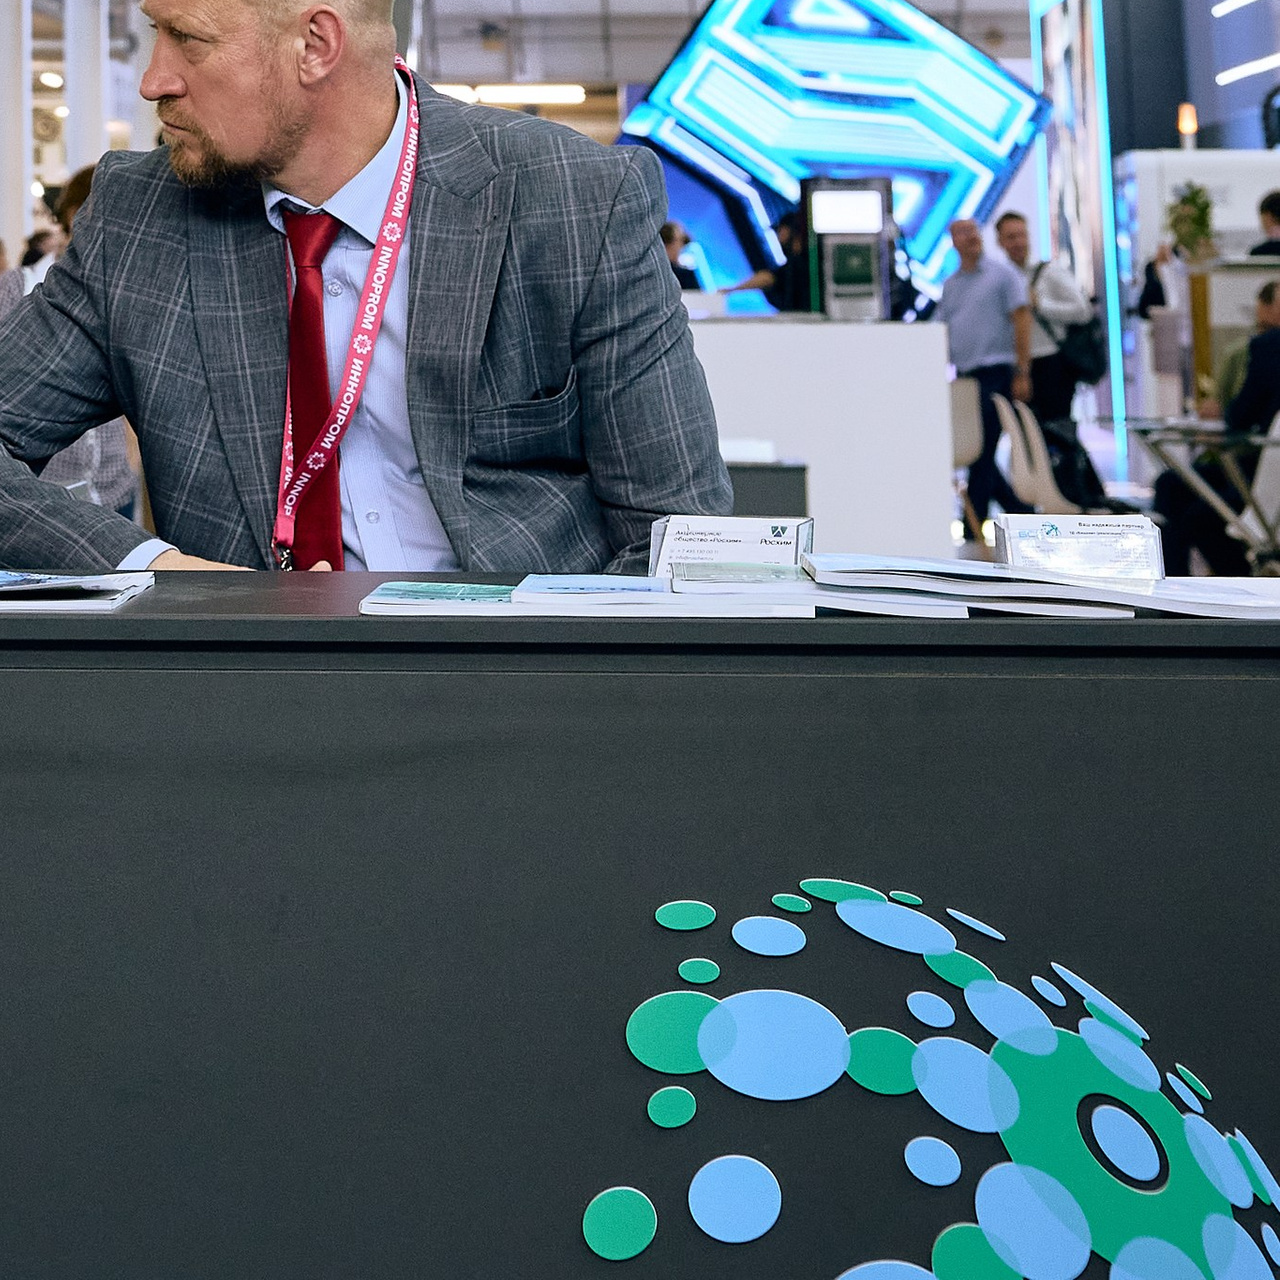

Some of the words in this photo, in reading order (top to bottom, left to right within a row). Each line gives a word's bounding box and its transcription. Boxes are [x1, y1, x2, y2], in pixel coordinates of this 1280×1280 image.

[391, 128, 419, 220] ИННОПРОМ
[360, 245, 394, 330] INNOPROM
[323, 357, 364, 451] ИННОПРОМ
[284, 470, 312, 517] INNOP
[674, 536, 709, 544] общество
